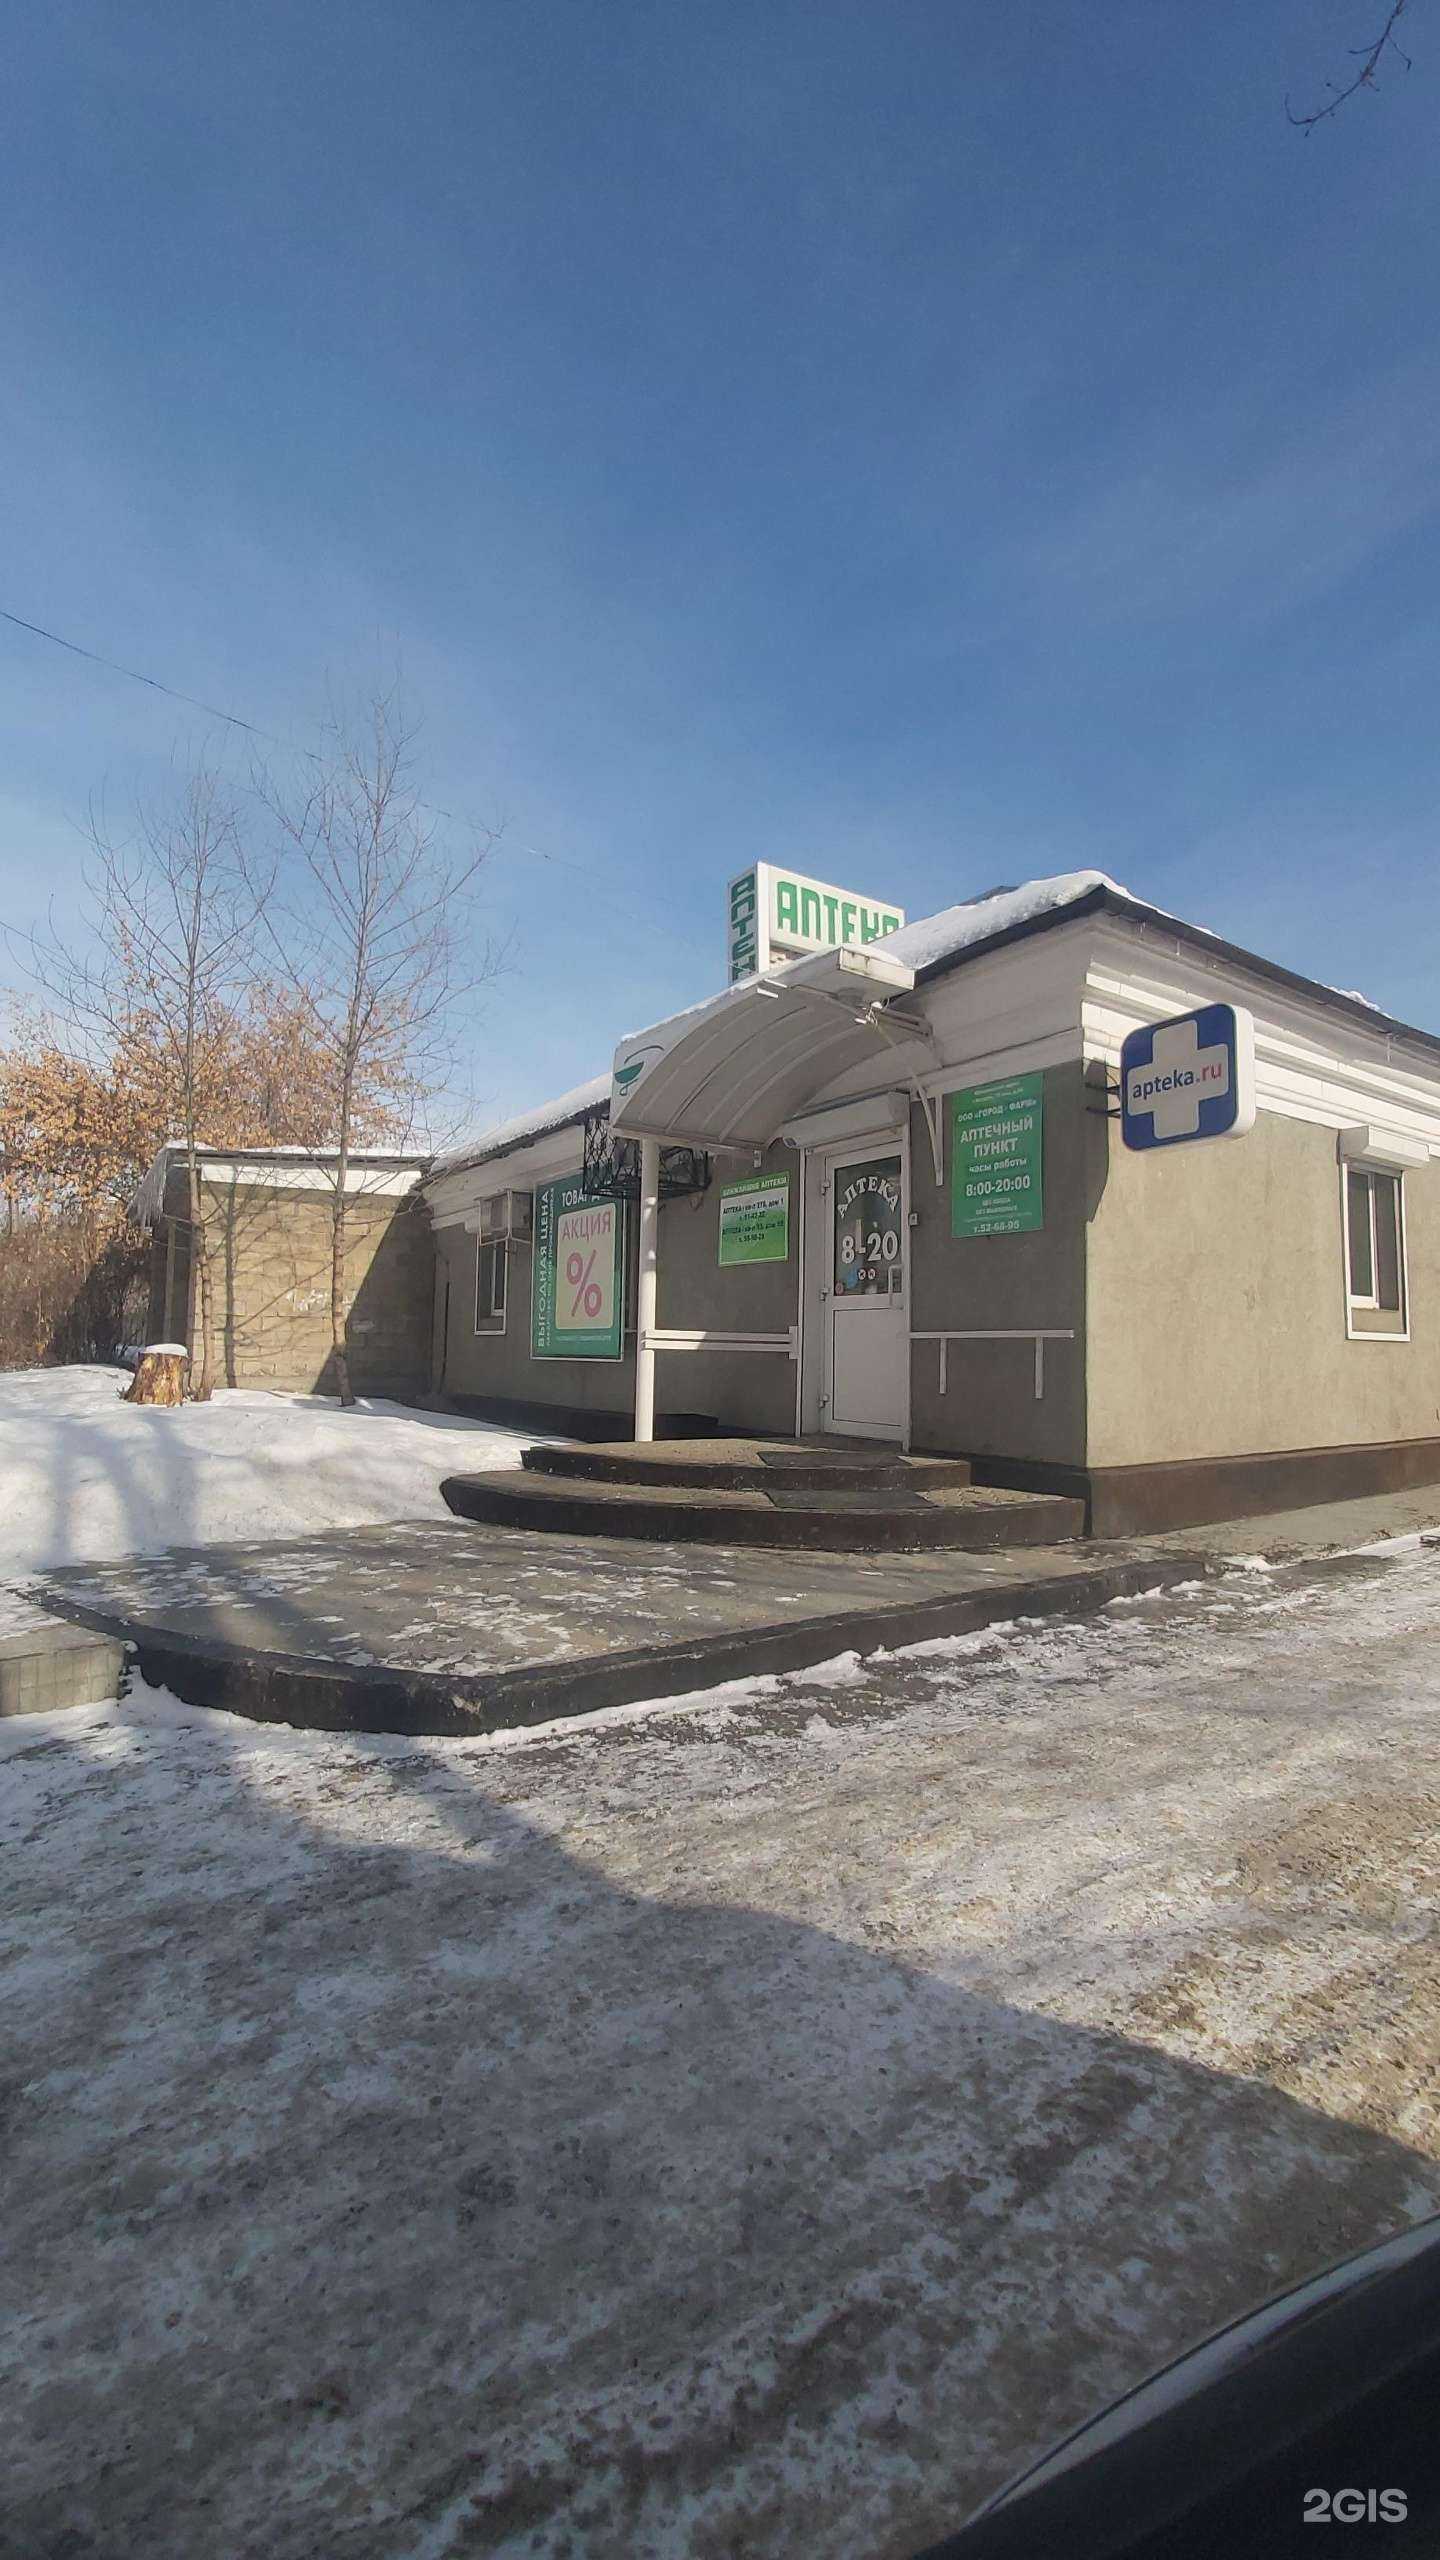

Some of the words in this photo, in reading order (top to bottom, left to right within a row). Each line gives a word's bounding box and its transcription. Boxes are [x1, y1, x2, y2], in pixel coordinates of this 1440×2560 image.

[1133, 1062, 1222, 1100] apteka.ru
[960, 1115, 1033, 1143] АПТЕЧНЫЙ
[974, 1137, 1018, 1158] ПУНКТ
[969, 1163, 991, 1173] часы
[994, 1158, 1027, 1171] работы
[561, 1186, 588, 1207] ТОВА
[837, 1176, 898, 1219] АПТЕКА
[966, 1174, 1031, 1197] 8:00-20:00
[540, 1189, 549, 1239] ЦЕНА
[562, 1211, 611, 1243] АКЦИЯ
[538, 1246, 549, 1348] ВЫГОДНАЯ
